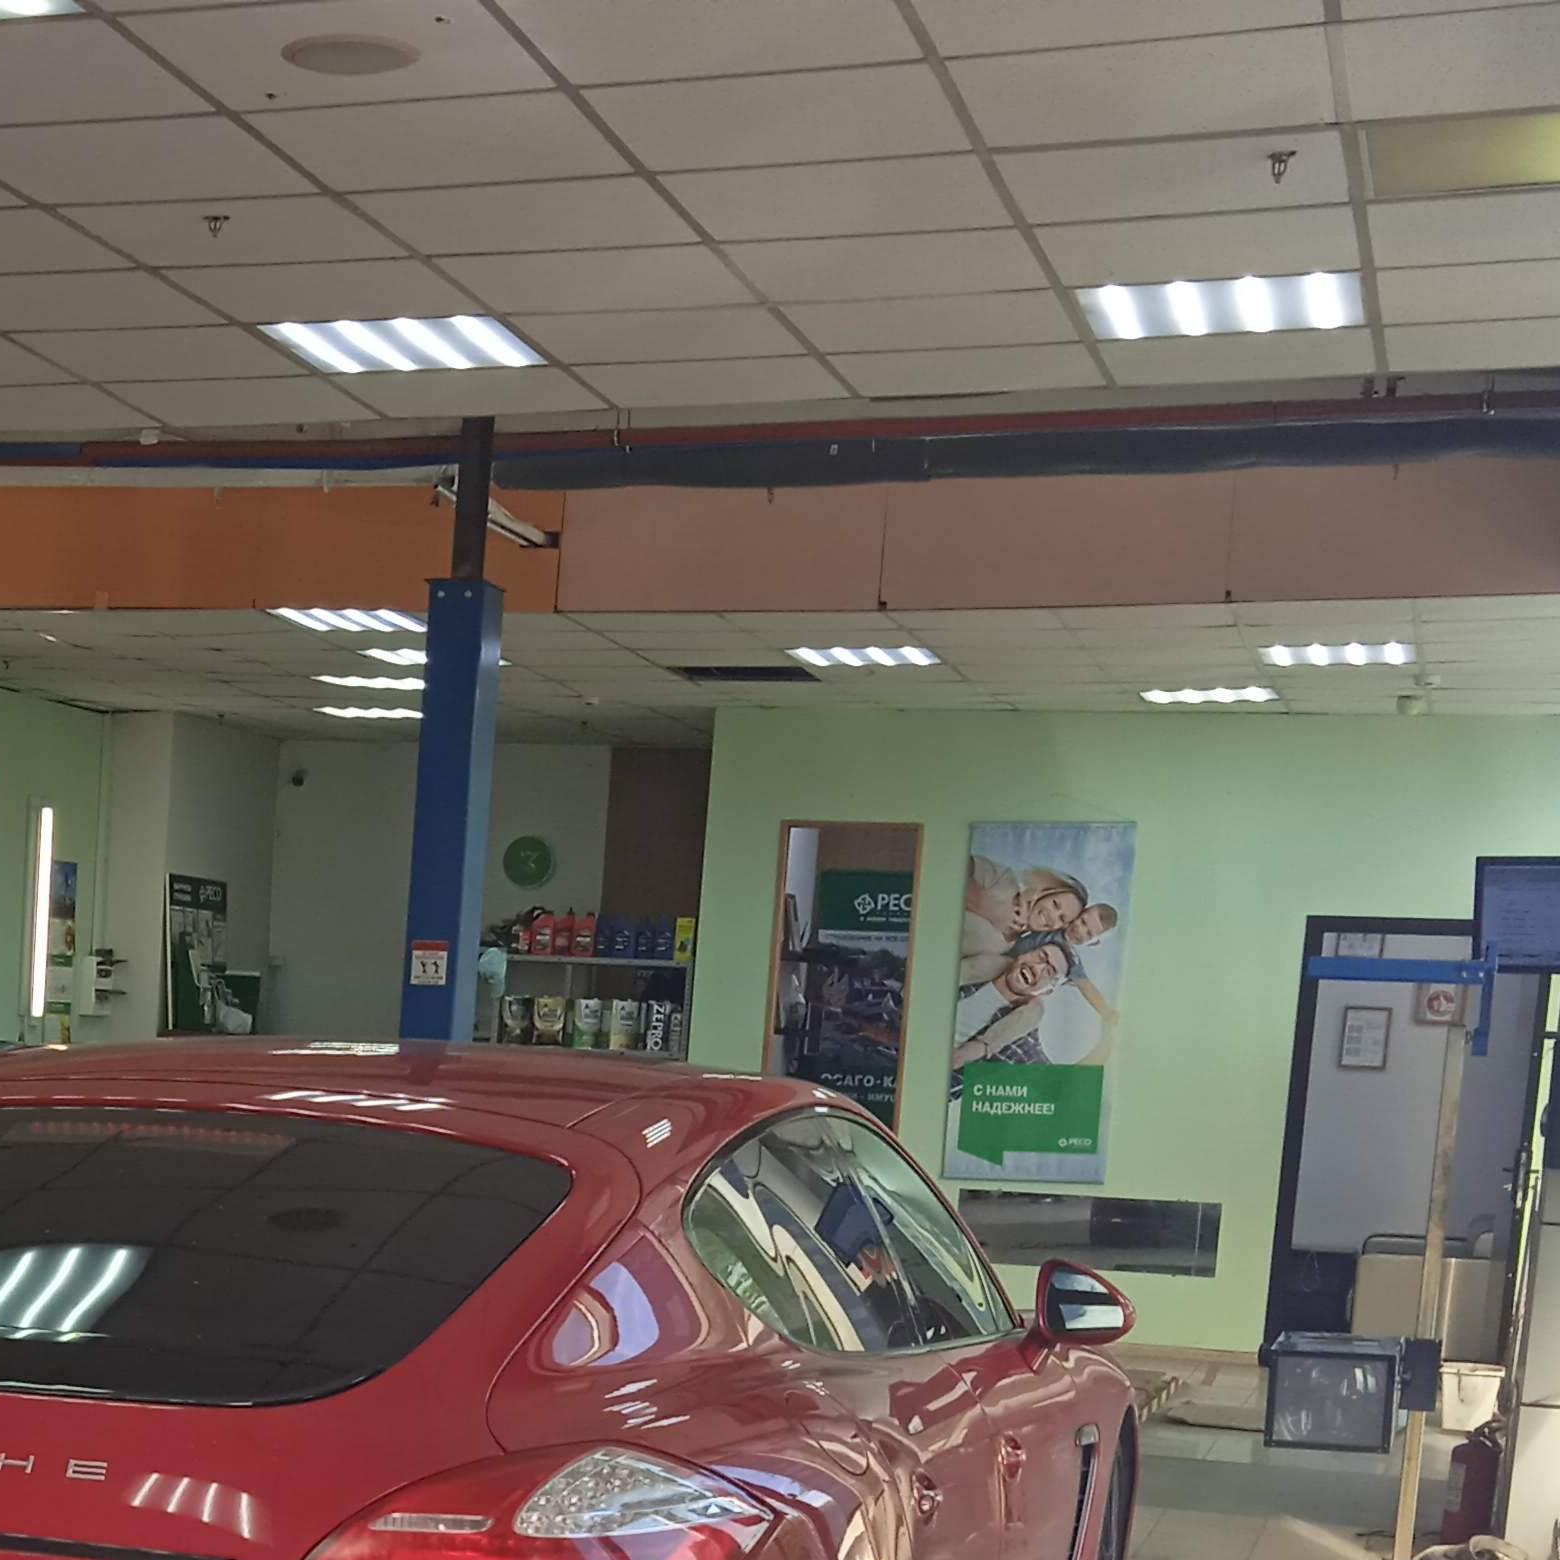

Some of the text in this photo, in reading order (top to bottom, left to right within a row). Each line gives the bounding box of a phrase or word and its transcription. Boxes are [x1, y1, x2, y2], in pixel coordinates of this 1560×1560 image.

[973, 1084, 1028, 1097] С НАМИ
[972, 1100, 1055, 1115] НАДЕЖНЕЕ!
